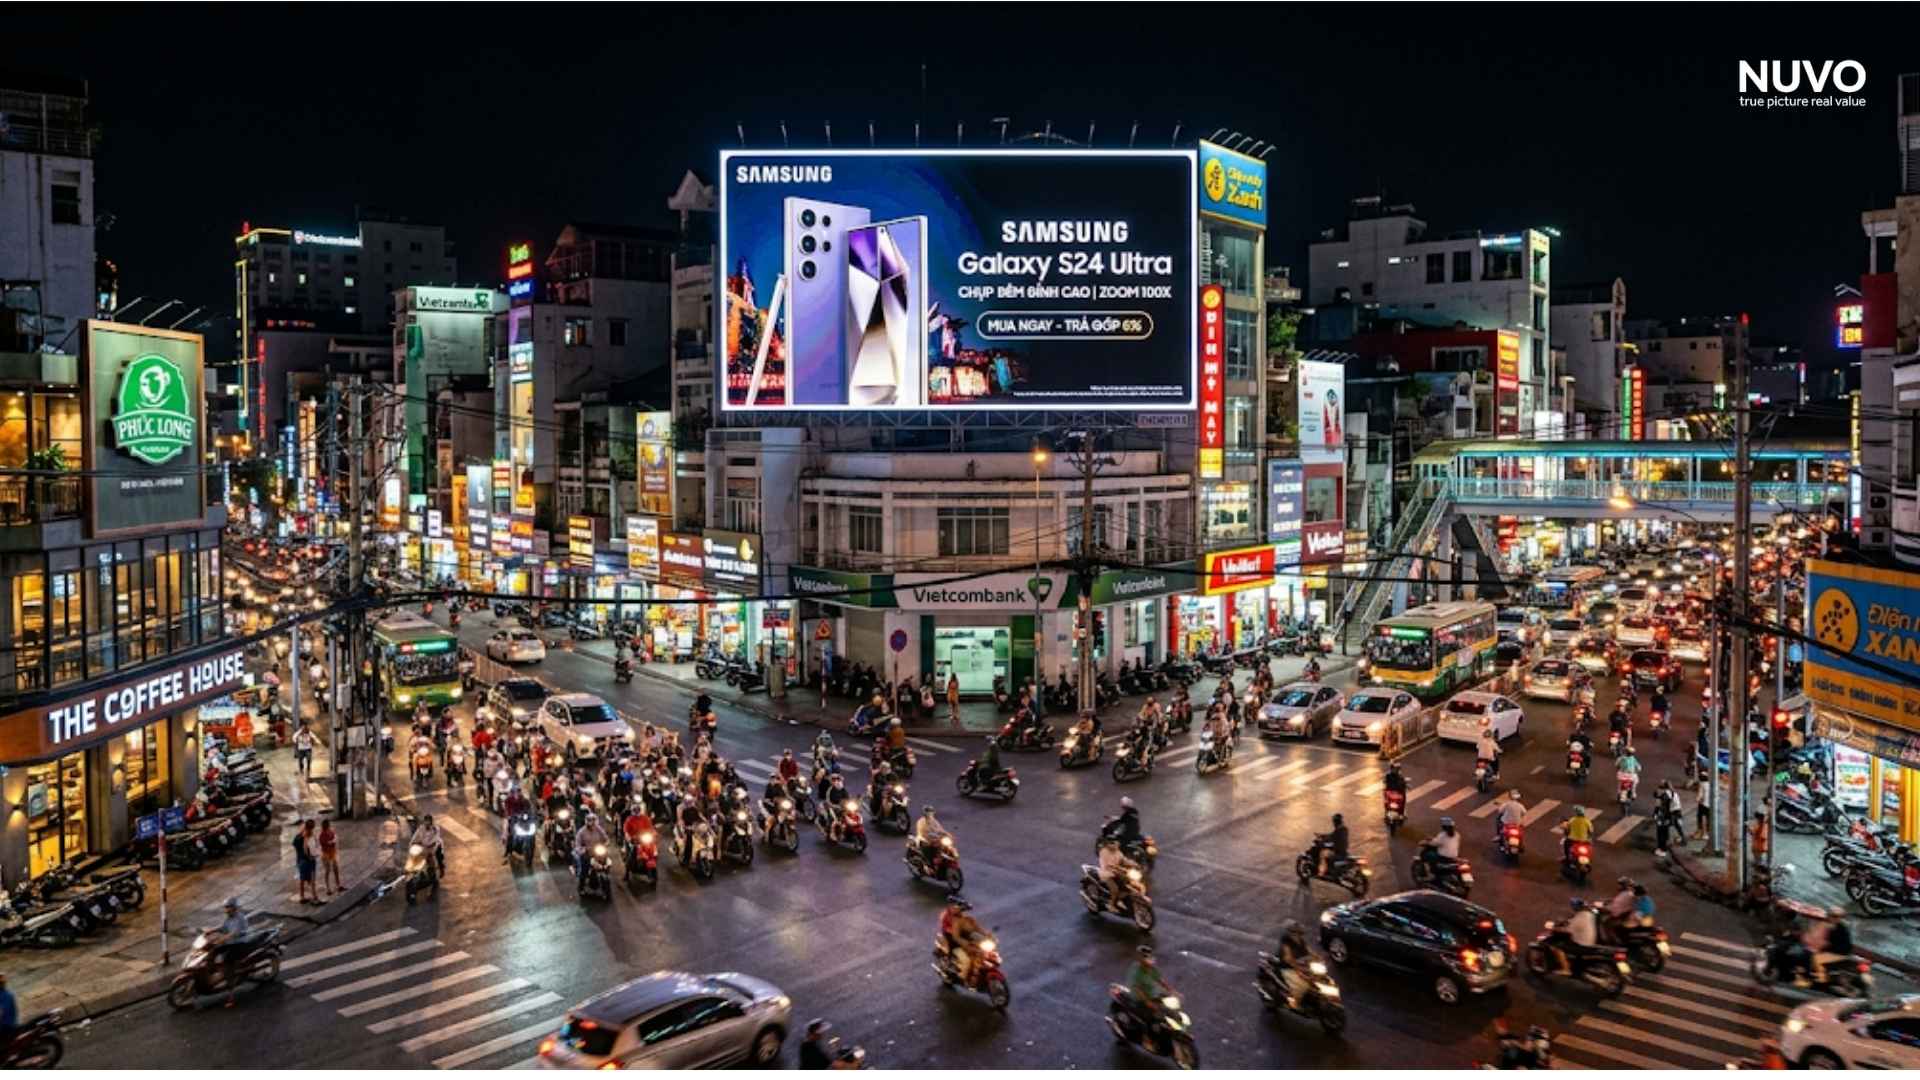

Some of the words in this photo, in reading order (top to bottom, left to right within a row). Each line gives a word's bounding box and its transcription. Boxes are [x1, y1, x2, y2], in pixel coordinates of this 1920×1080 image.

[736, 165, 833, 183] SAMSUNG
[1001, 221, 1129, 243] SAMSUNG
[958, 251, 1052, 281] Galaxy
[1058, 251, 1105, 274] S24
[1110, 251, 1172, 274] Ultra
[1061, 286, 1091, 299] CAO
[1098, 286, 1140, 298] ZOOM
[1141, 286, 1172, 298] 100X
[988, 319, 1016, 333] MUA
[1018, 319, 1053, 333] NGAY
[157, 418, 192, 440] LONG
[913, 588, 1027, 603] Vietcombank
[49, 699, 97, 744] THE
[104, 670, 184, 724] COFFEE
[190, 651, 244, 694] HOUSE
